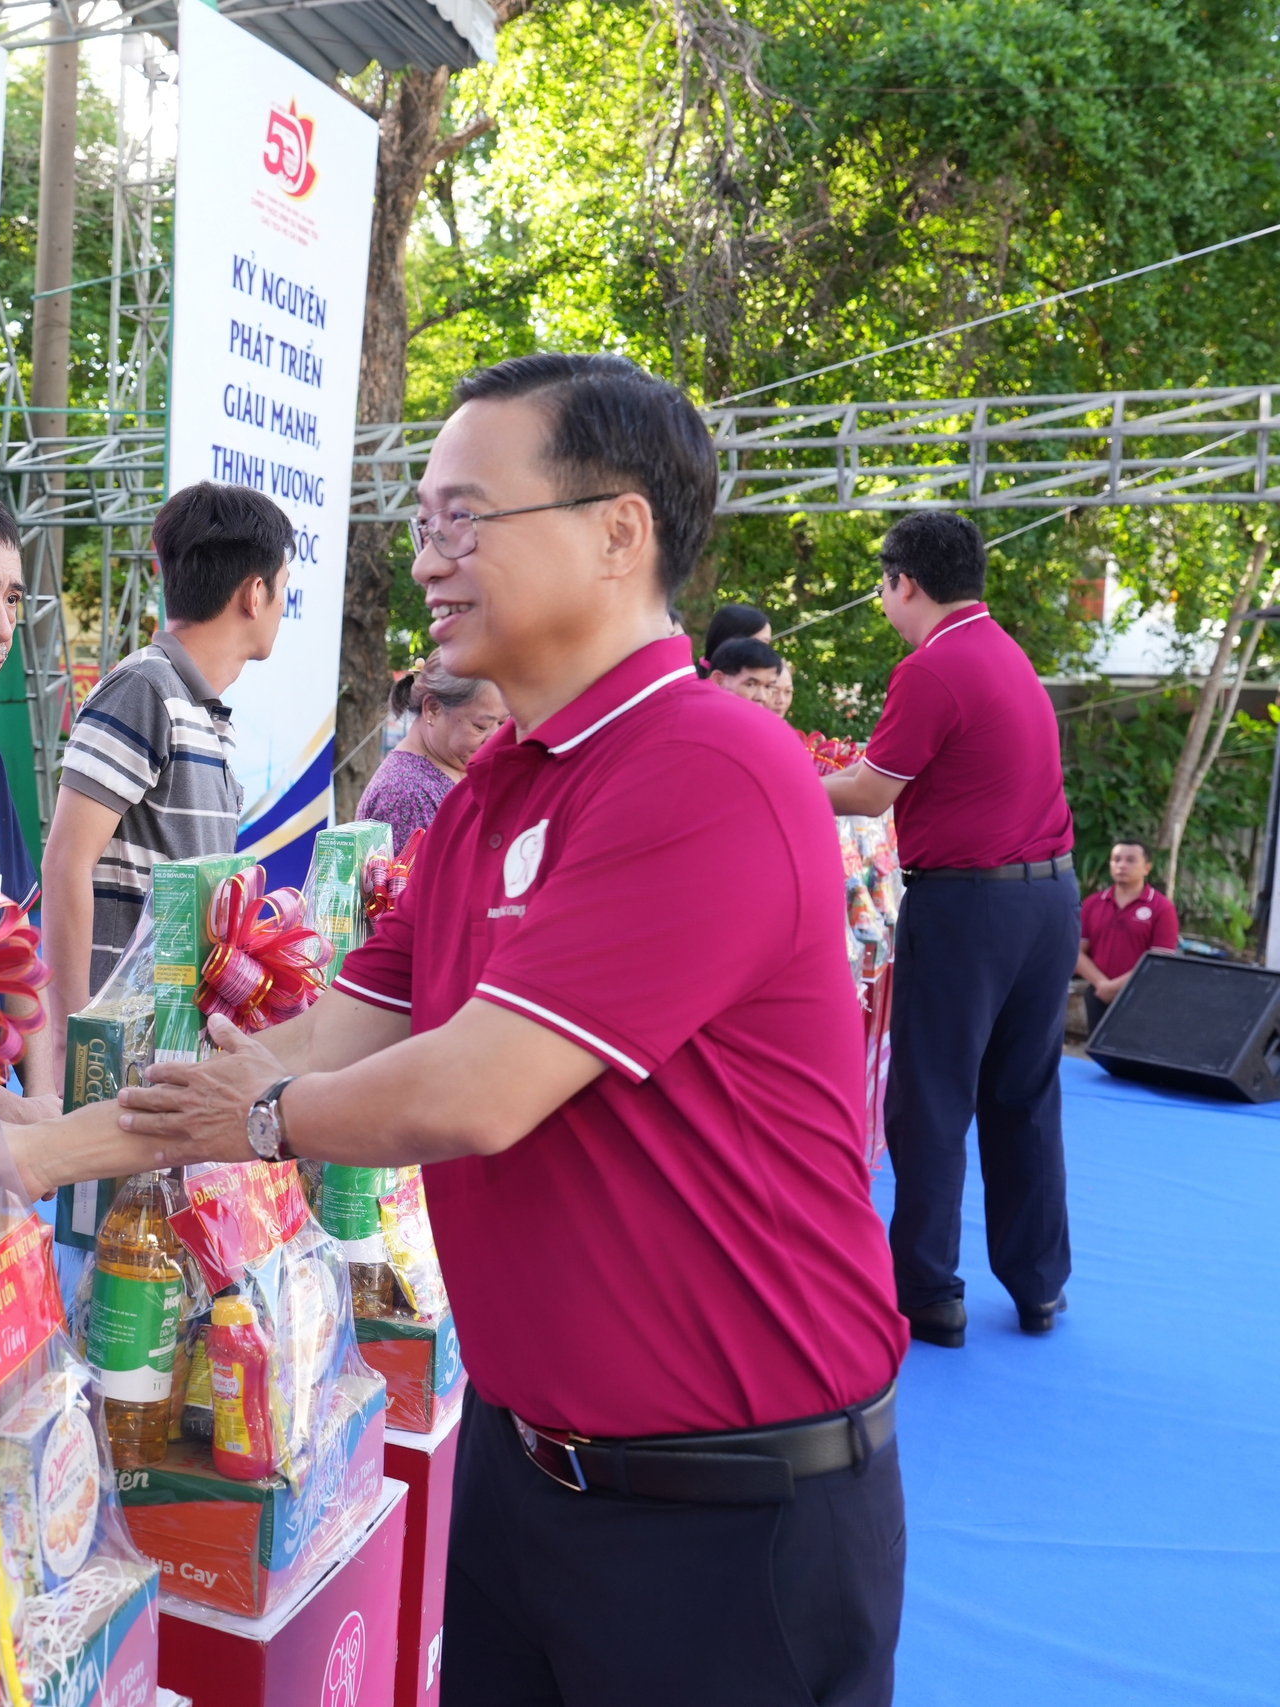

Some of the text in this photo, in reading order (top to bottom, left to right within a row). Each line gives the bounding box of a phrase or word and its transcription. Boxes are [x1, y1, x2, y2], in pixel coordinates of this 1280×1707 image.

[232, 250, 326, 330] KỶ NGUYÊN
[230, 318, 322, 389] PHÁT TRIỂN
[224, 382, 321, 451] GIÀU MẠNH,
[270, 462, 324, 508] VƯỢNG
[293, 524, 320, 568] ỘC
[180, 1562, 218, 1588] Cay
